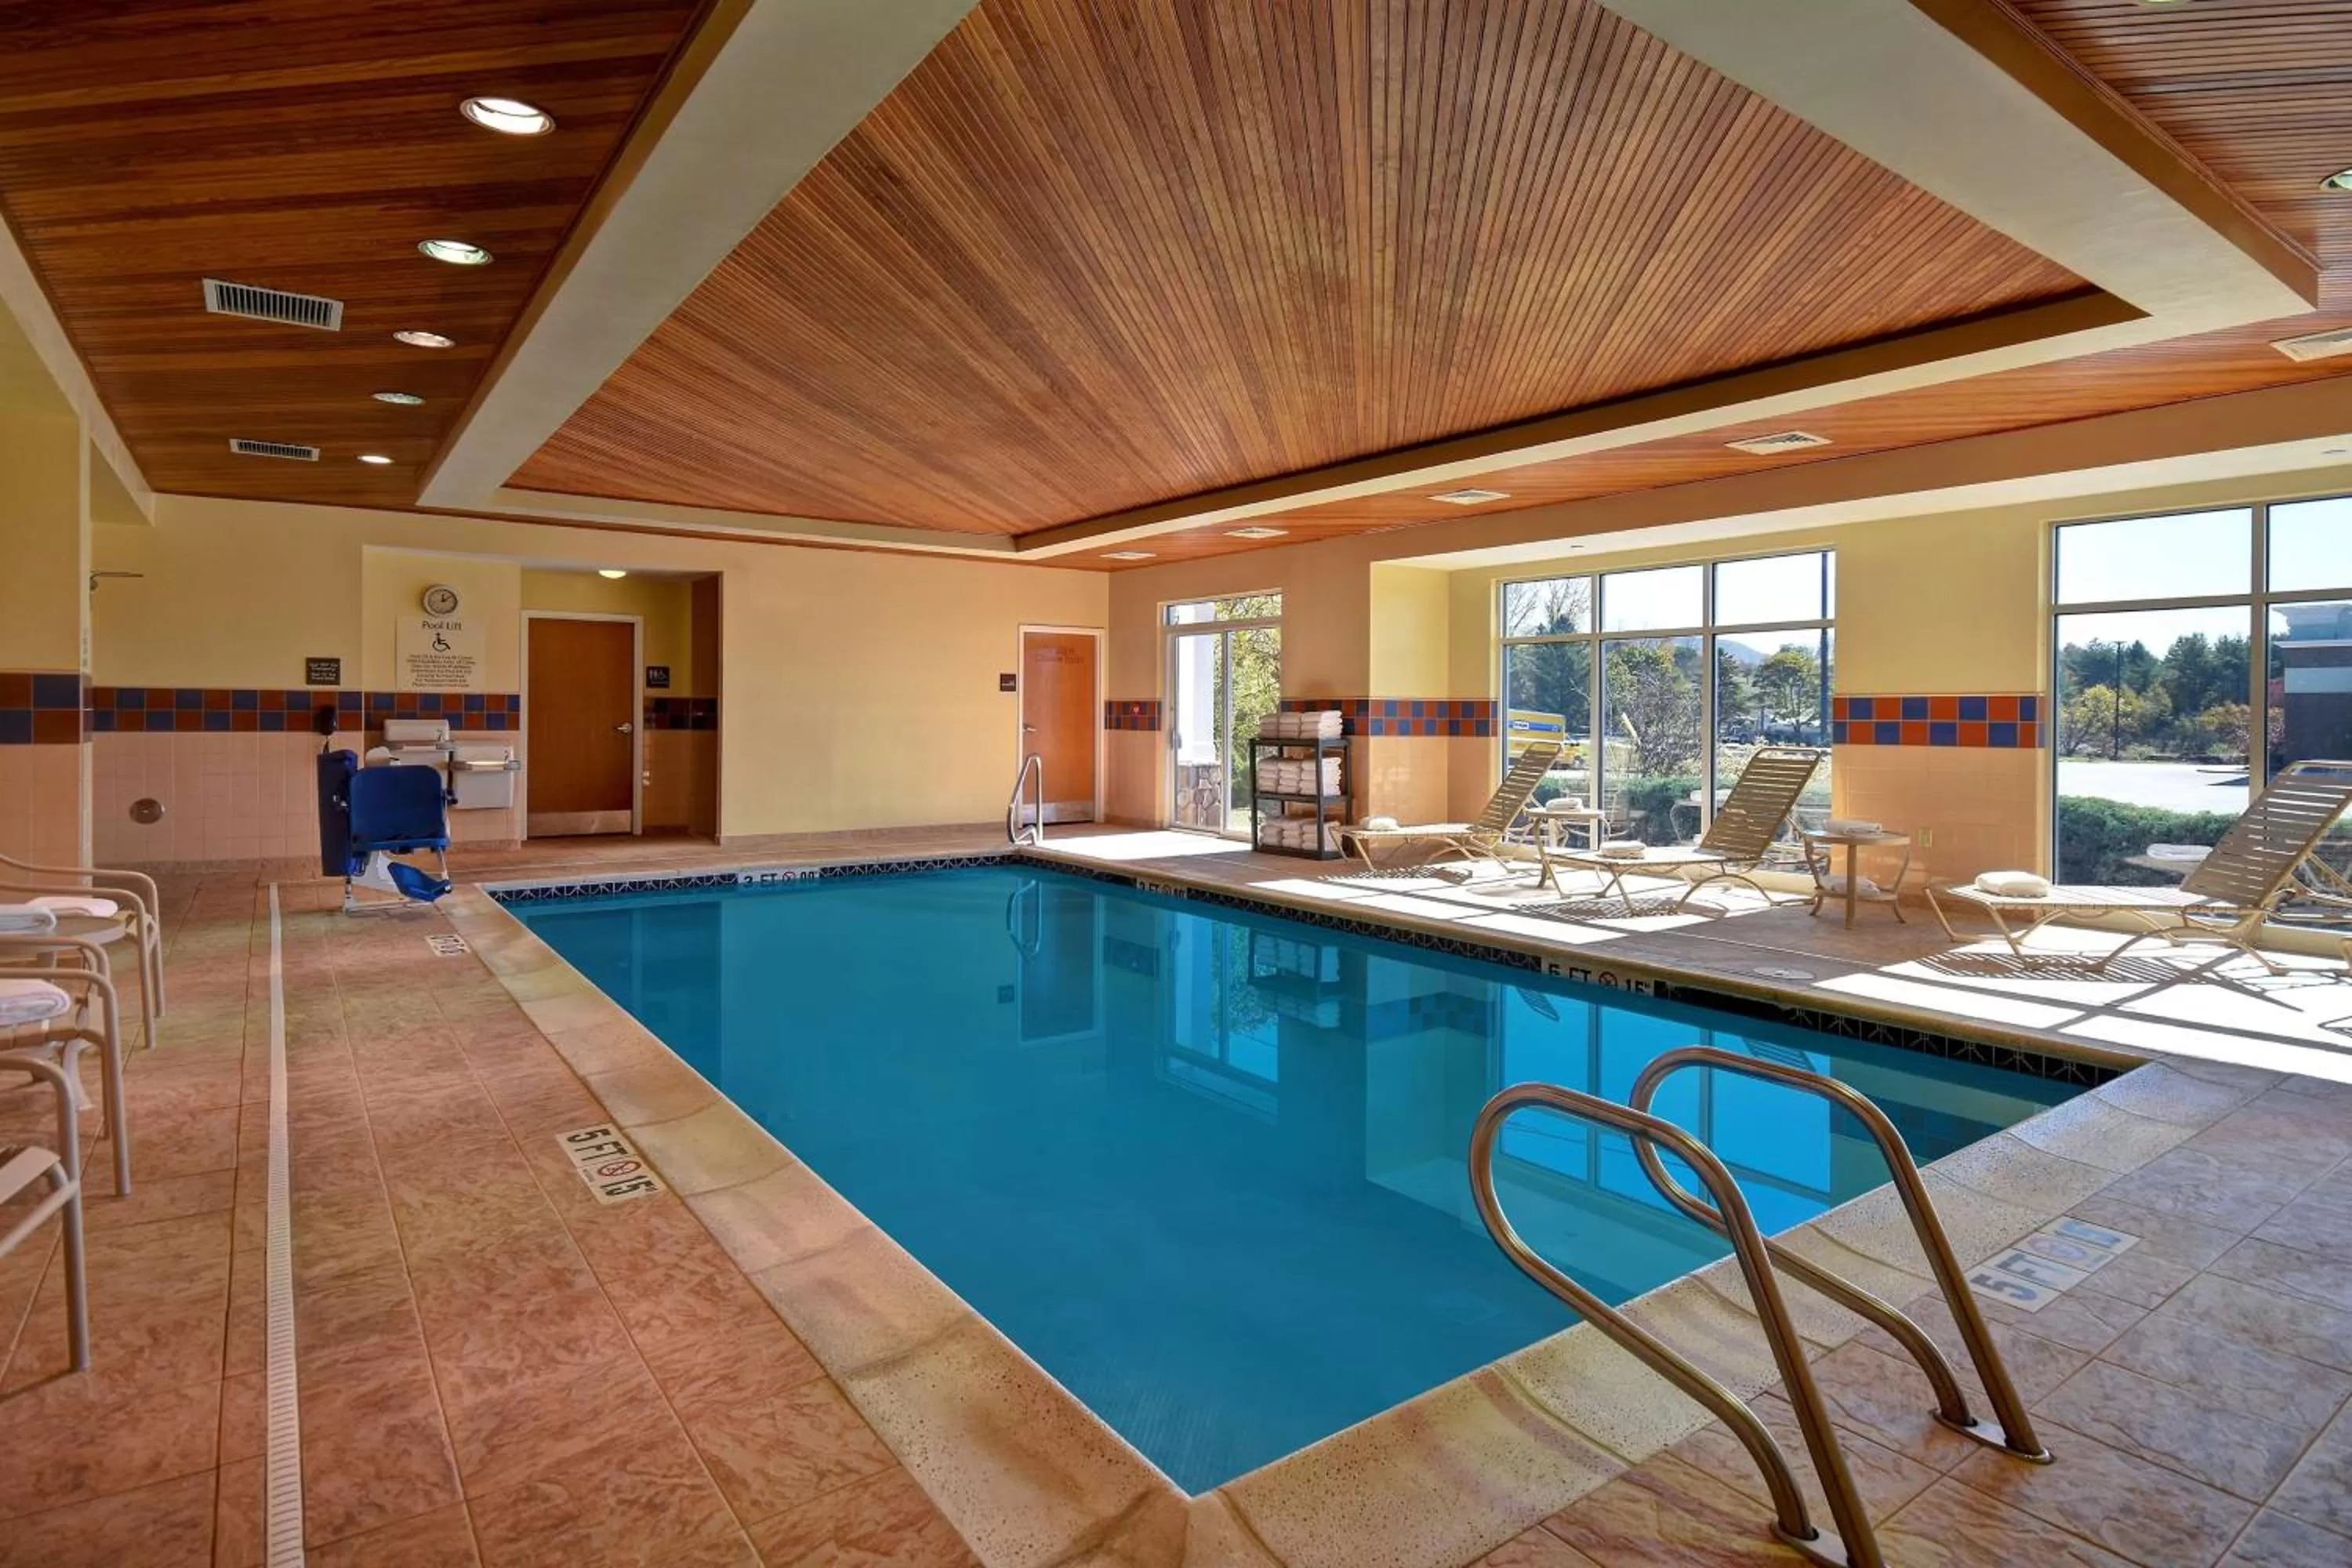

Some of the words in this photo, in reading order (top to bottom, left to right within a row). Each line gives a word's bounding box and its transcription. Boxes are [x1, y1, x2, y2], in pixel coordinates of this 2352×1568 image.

[422, 620, 444, 630] Pool
[567, 1128, 612, 1142] 5
[574, 1141, 628, 1162] FT
[1995, 1253, 2076, 1286] FT
[1969, 1272, 2038, 1301] 5
